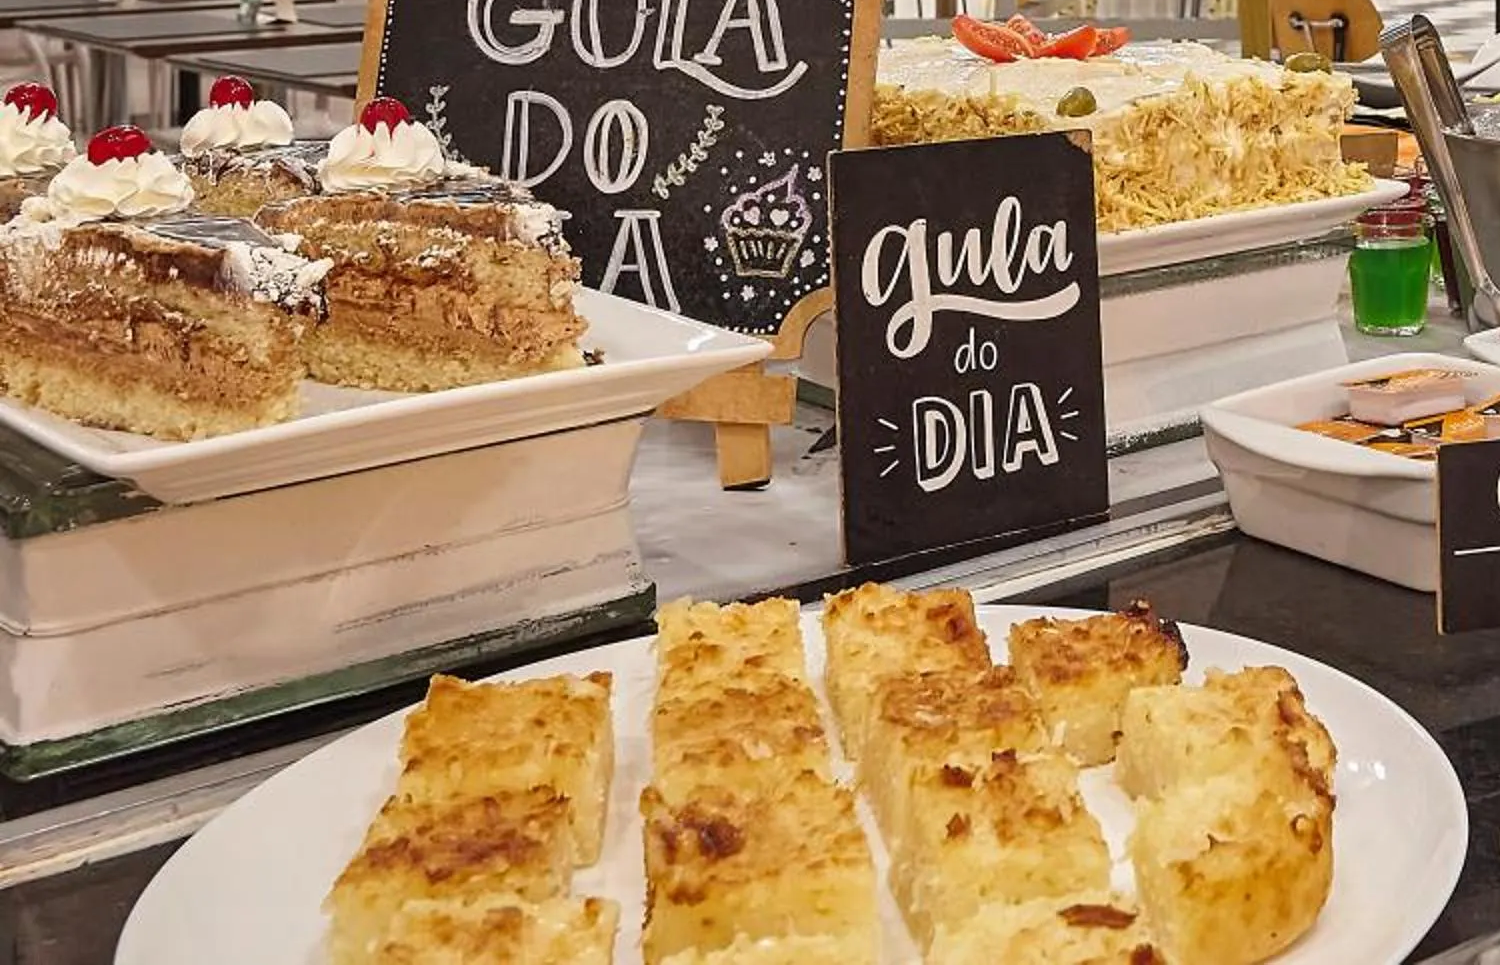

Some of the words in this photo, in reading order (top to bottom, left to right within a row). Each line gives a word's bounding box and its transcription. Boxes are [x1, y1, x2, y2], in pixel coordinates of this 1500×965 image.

[502, 91, 650, 194] DO
[954, 327, 998, 374] do
[912, 383, 1060, 492] DIA
